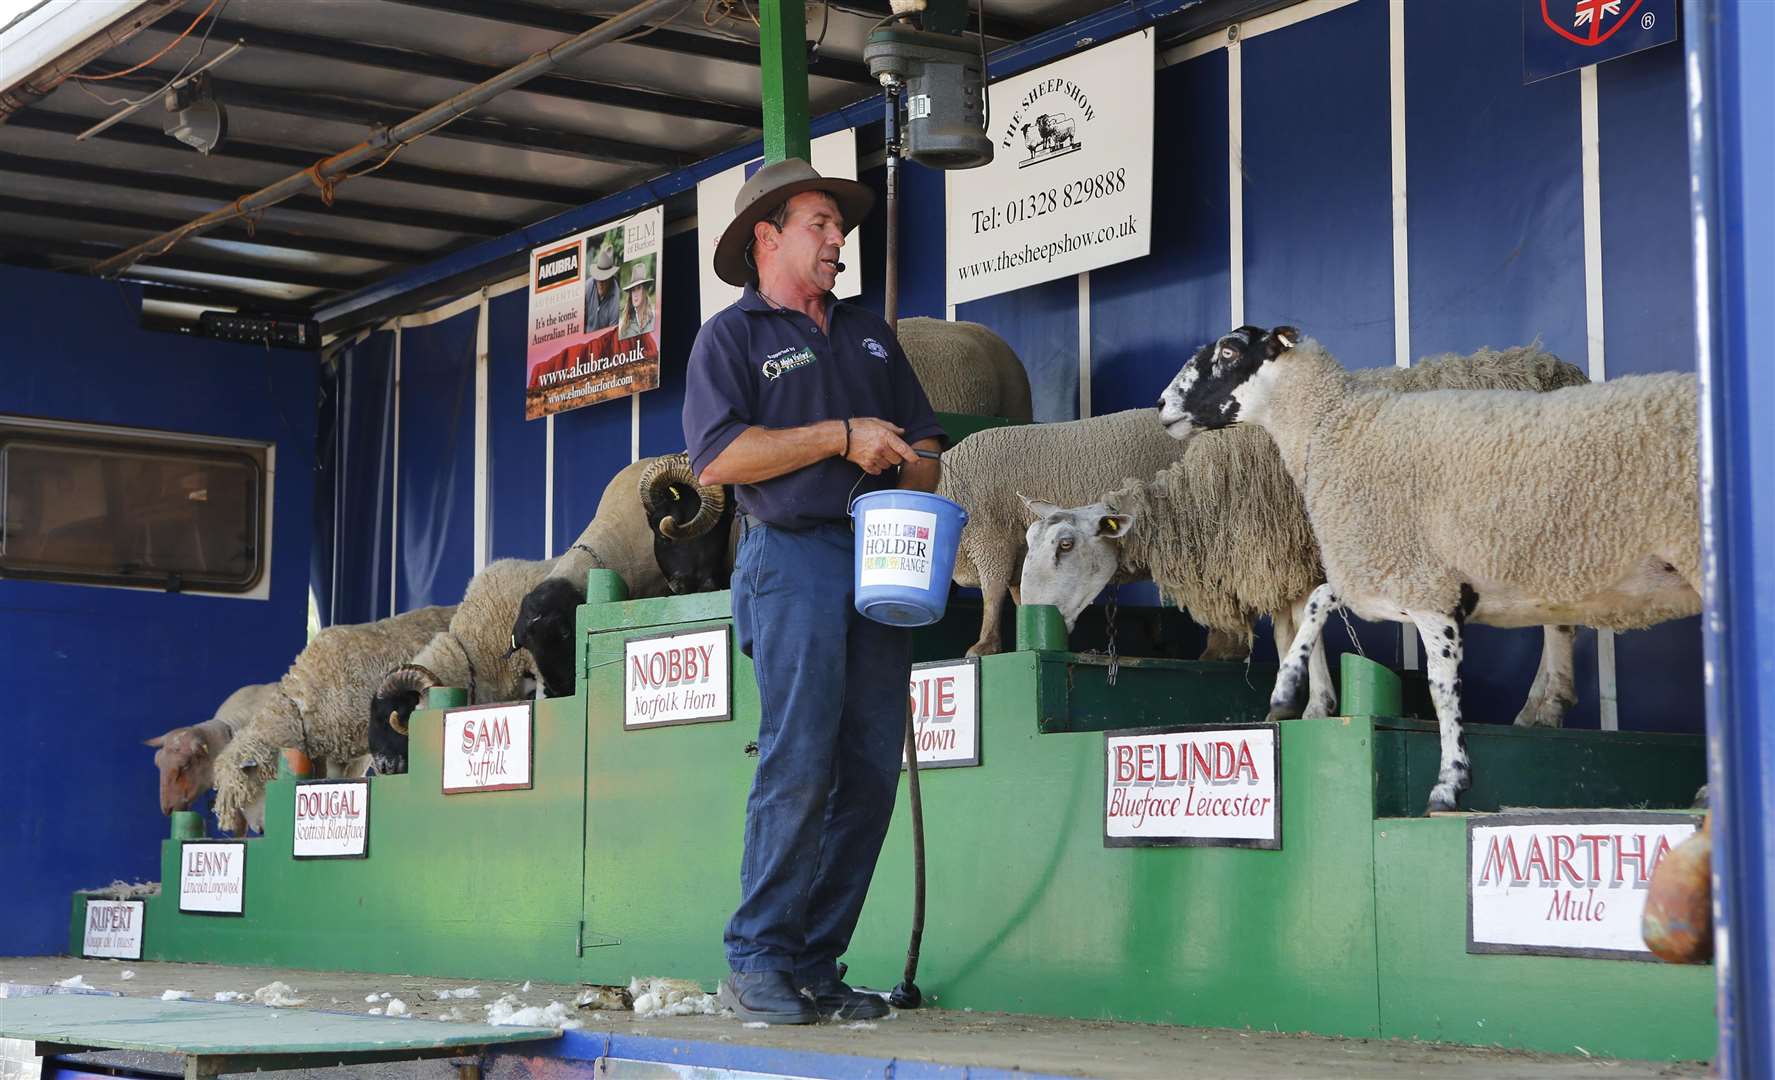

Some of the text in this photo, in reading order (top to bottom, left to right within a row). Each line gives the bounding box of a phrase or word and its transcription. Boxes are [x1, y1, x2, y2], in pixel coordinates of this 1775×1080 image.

[1002, 78, 1097, 150] THE SHEEP SHOW
[972, 167, 1126, 235] Tel: 01328 829888
[628, 221, 656, 244] ELM
[958, 214, 1138, 281] www.thesheepshow.co.uk
[538, 254, 578, 281] AKUBRA
[535, 309, 578, 330] It's the iconic
[532, 325, 580, 346] Australian Hat
[538, 340, 645, 387] www.akubra.co.uk
[548, 374, 633, 404] www.elmofburford.com
[866, 523, 901, 538] SMALL
[865, 538, 927, 558] HOLDER
[900, 557, 927, 574] RANGE
[631, 644, 714, 691] NOBBY
[633, 690, 716, 720] Norfolk Horn
[462, 715, 511, 754] SAM
[466, 750, 508, 786] Suffolk
[1113, 739, 1260, 787] BELINDA
[297, 790, 360, 820] DOUGAL
[1109, 786, 1271, 829] Blueface Leicester
[296, 820, 326, 840] Scottish
[187, 852, 232, 877] LENNY
[90, 906, 135, 932] RUPERT
[1545, 888, 1606, 922] Mule
